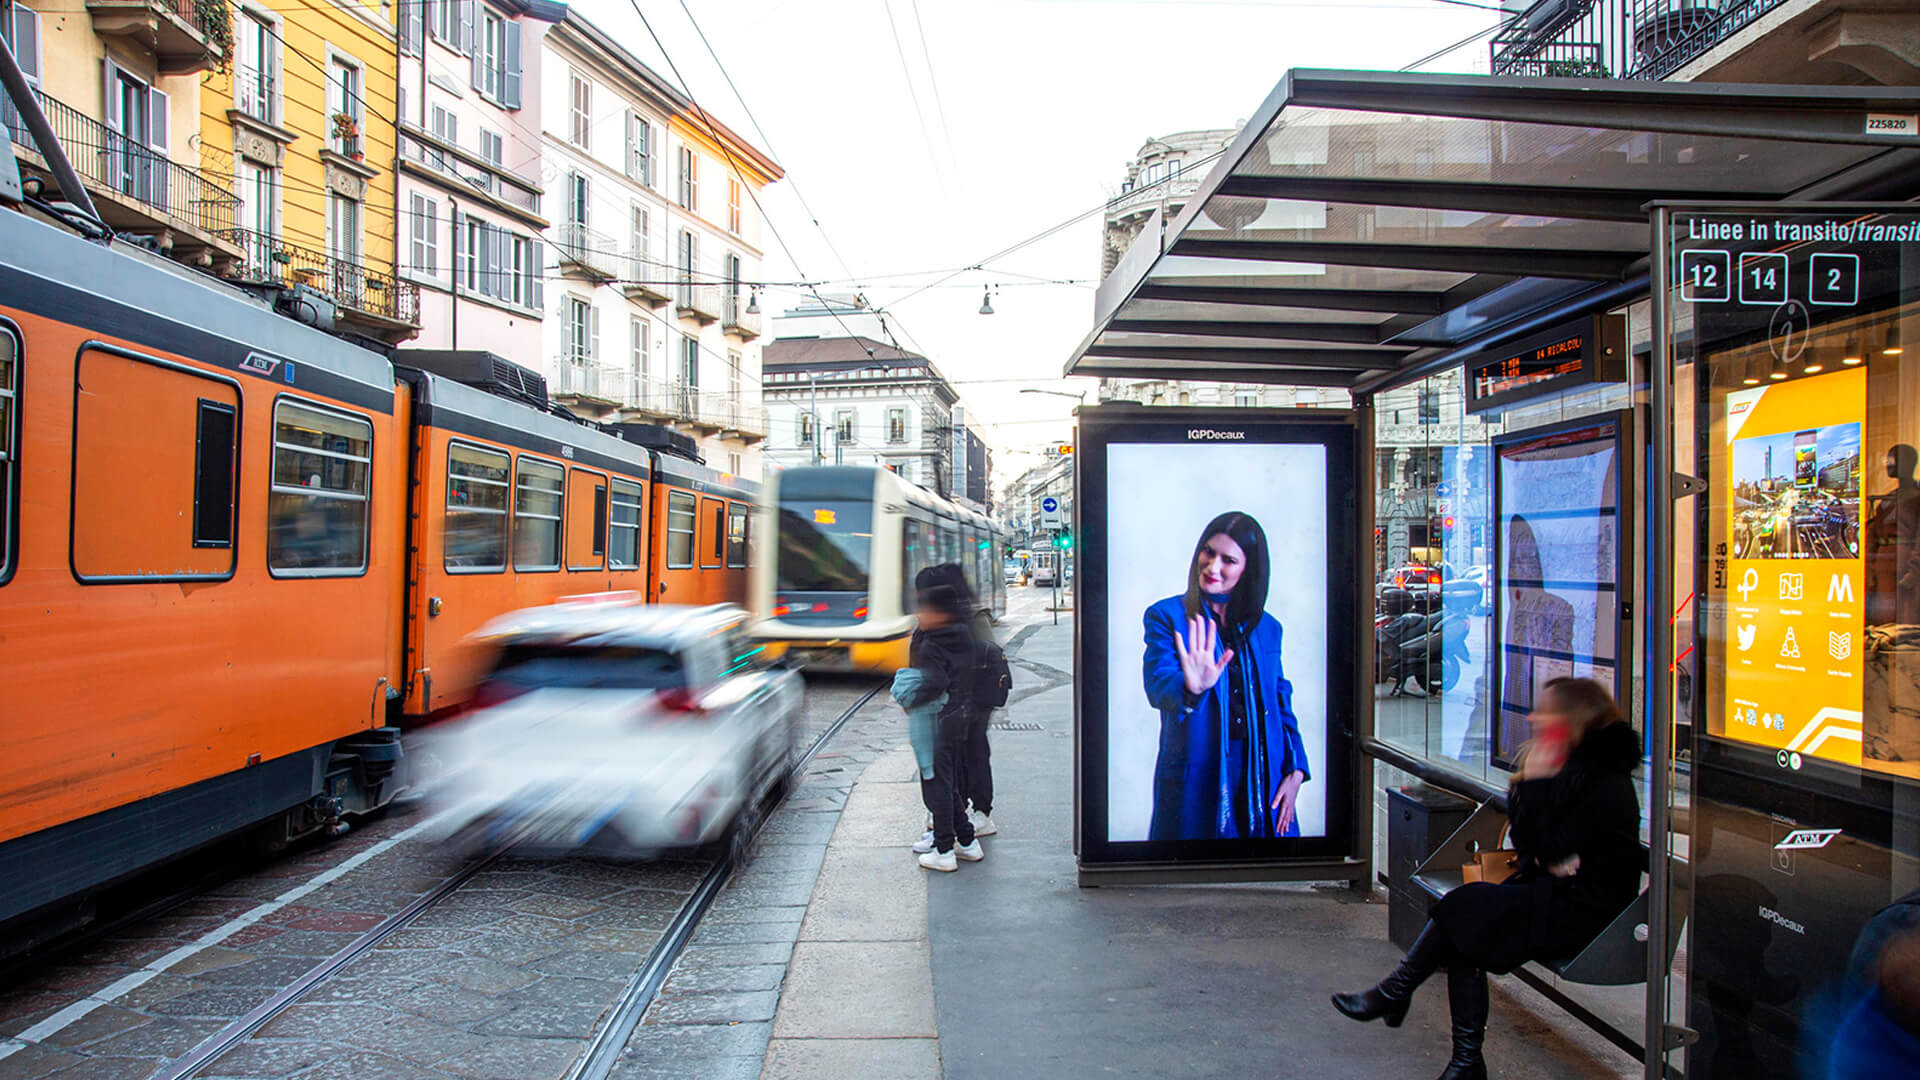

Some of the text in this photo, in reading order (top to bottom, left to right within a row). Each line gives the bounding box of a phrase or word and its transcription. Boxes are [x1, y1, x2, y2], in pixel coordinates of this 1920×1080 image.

[1868, 119, 1907, 129] 225820
[1689, 218, 1744, 240] Linee
[1750, 219, 1769, 241] in
[1690, 264, 1841, 291] 12 14 2
[1187, 429, 1245, 440] IGPDecaux
[1793, 833, 1821, 845] ATM
[1758, 905, 1806, 935] IGPDecaux
